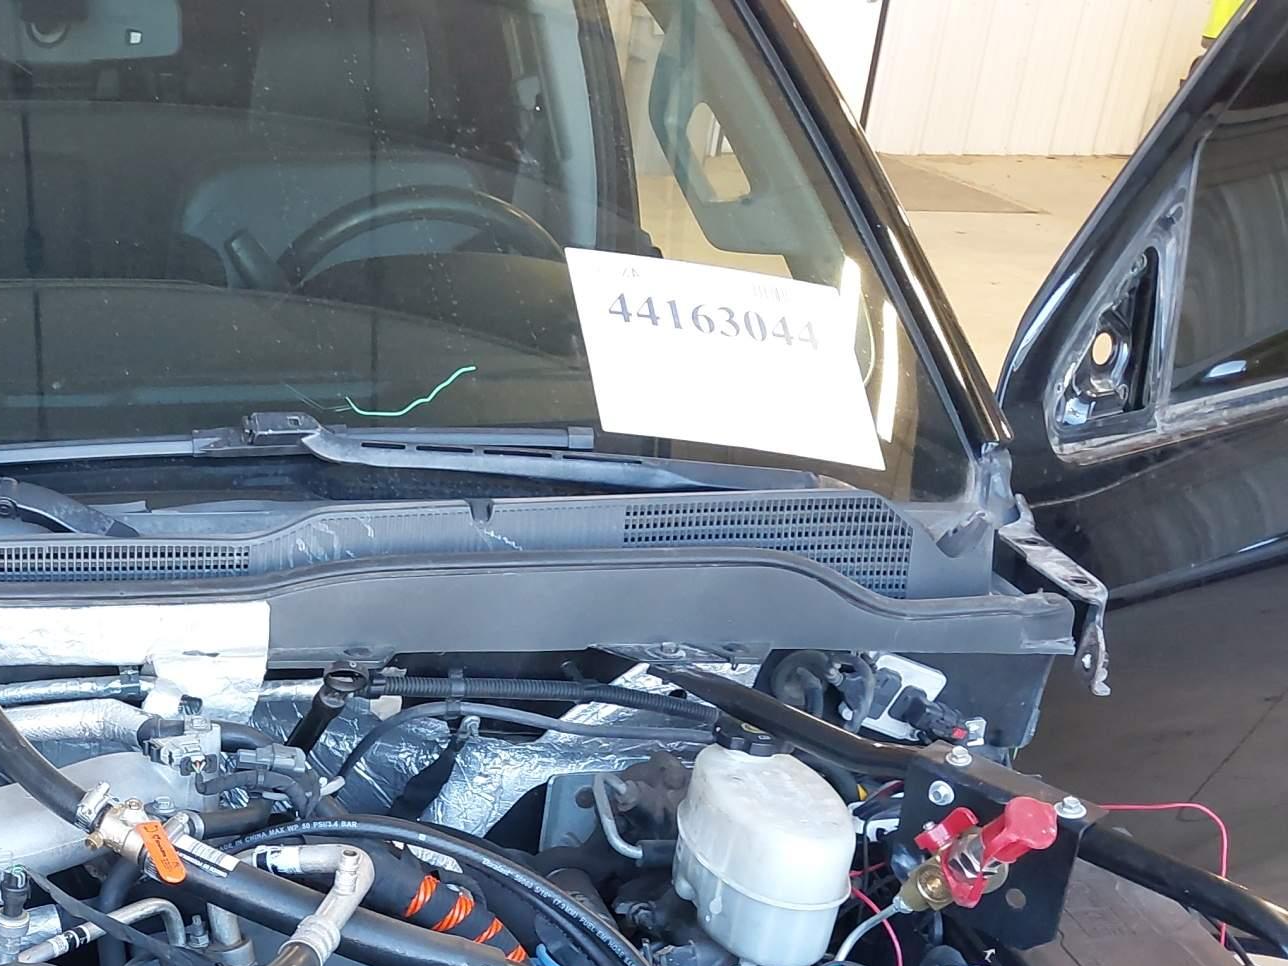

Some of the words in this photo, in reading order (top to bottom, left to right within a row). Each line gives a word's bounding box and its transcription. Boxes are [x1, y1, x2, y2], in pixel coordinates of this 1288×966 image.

[608, 292, 819, 351] 44163044
[244, 831, 268, 843] CHINA
[268, 826, 286, 836] MAX
[340, 820, 359, 828] BAR
[578, 916, 597, 933] FUEL
